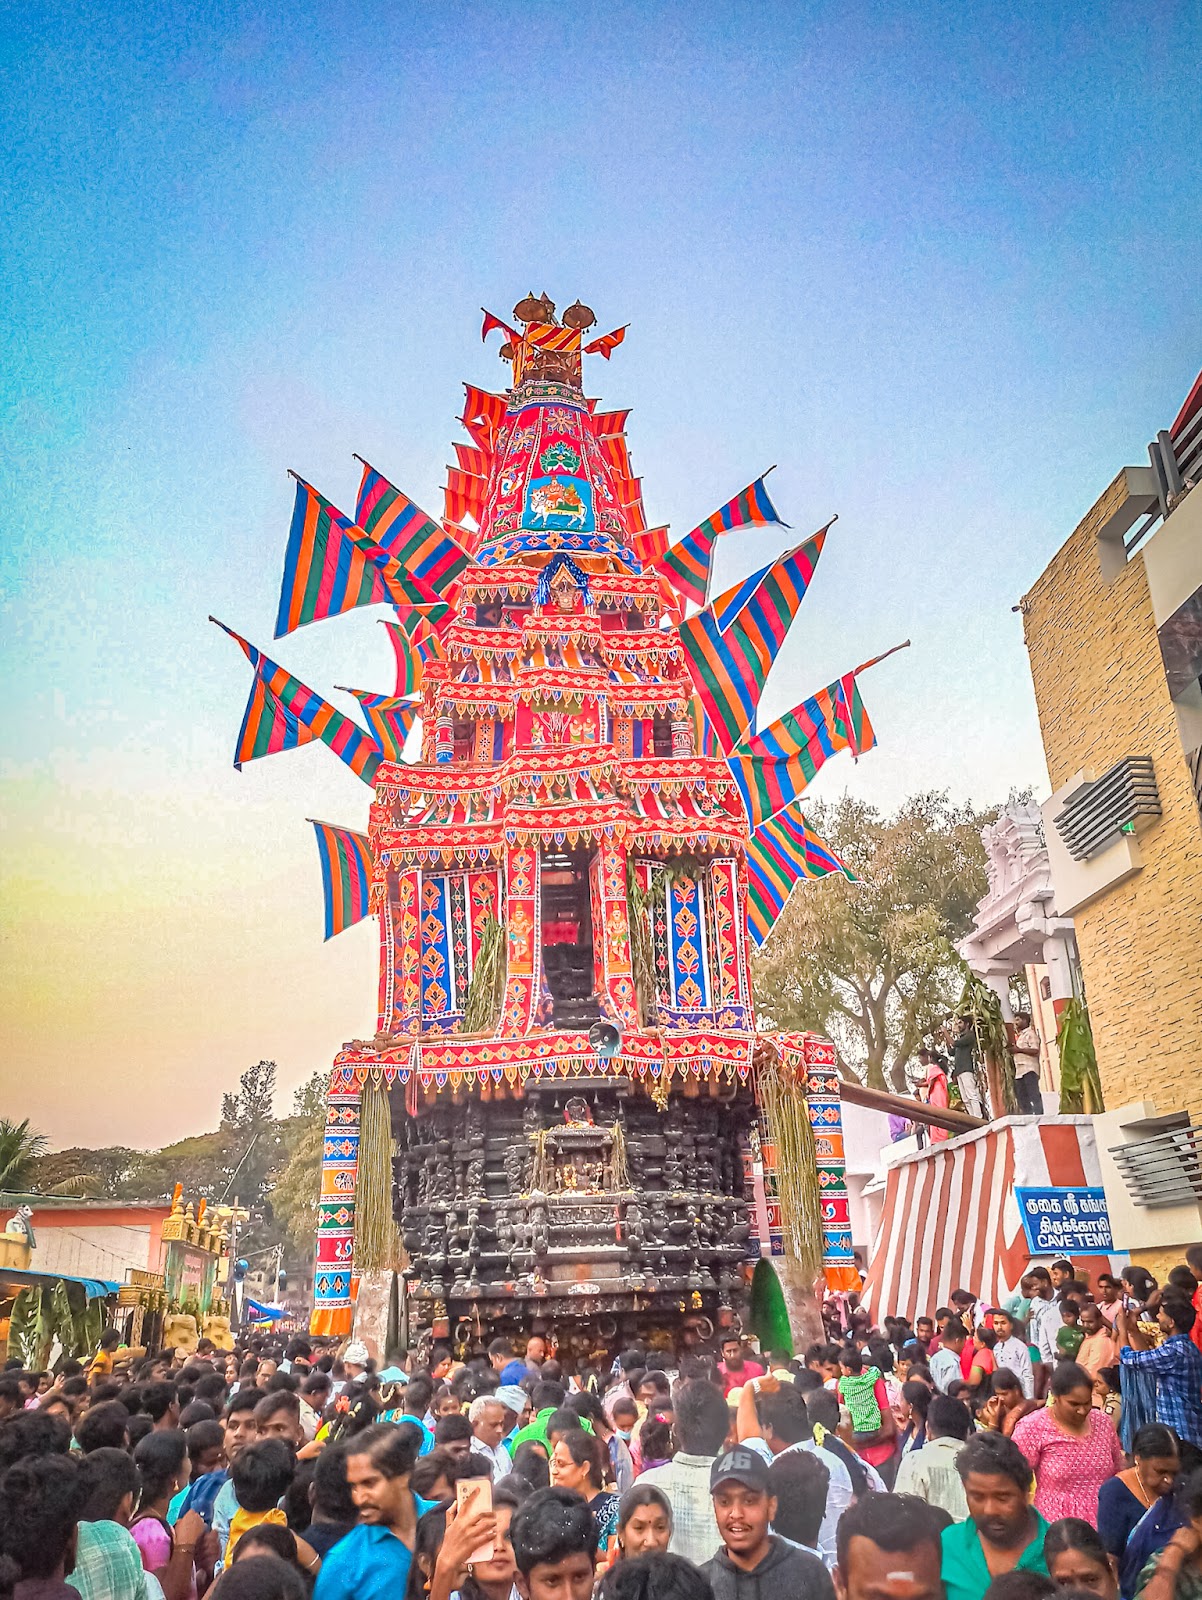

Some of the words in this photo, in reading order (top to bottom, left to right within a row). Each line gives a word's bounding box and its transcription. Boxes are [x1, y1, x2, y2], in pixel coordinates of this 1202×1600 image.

[1026, 1198, 1061, 1215] குகை
[1037, 1234, 1074, 1248] CAVE
[1073, 1232, 1112, 1248] TEMP
[717, 1451, 752, 1473] 46
